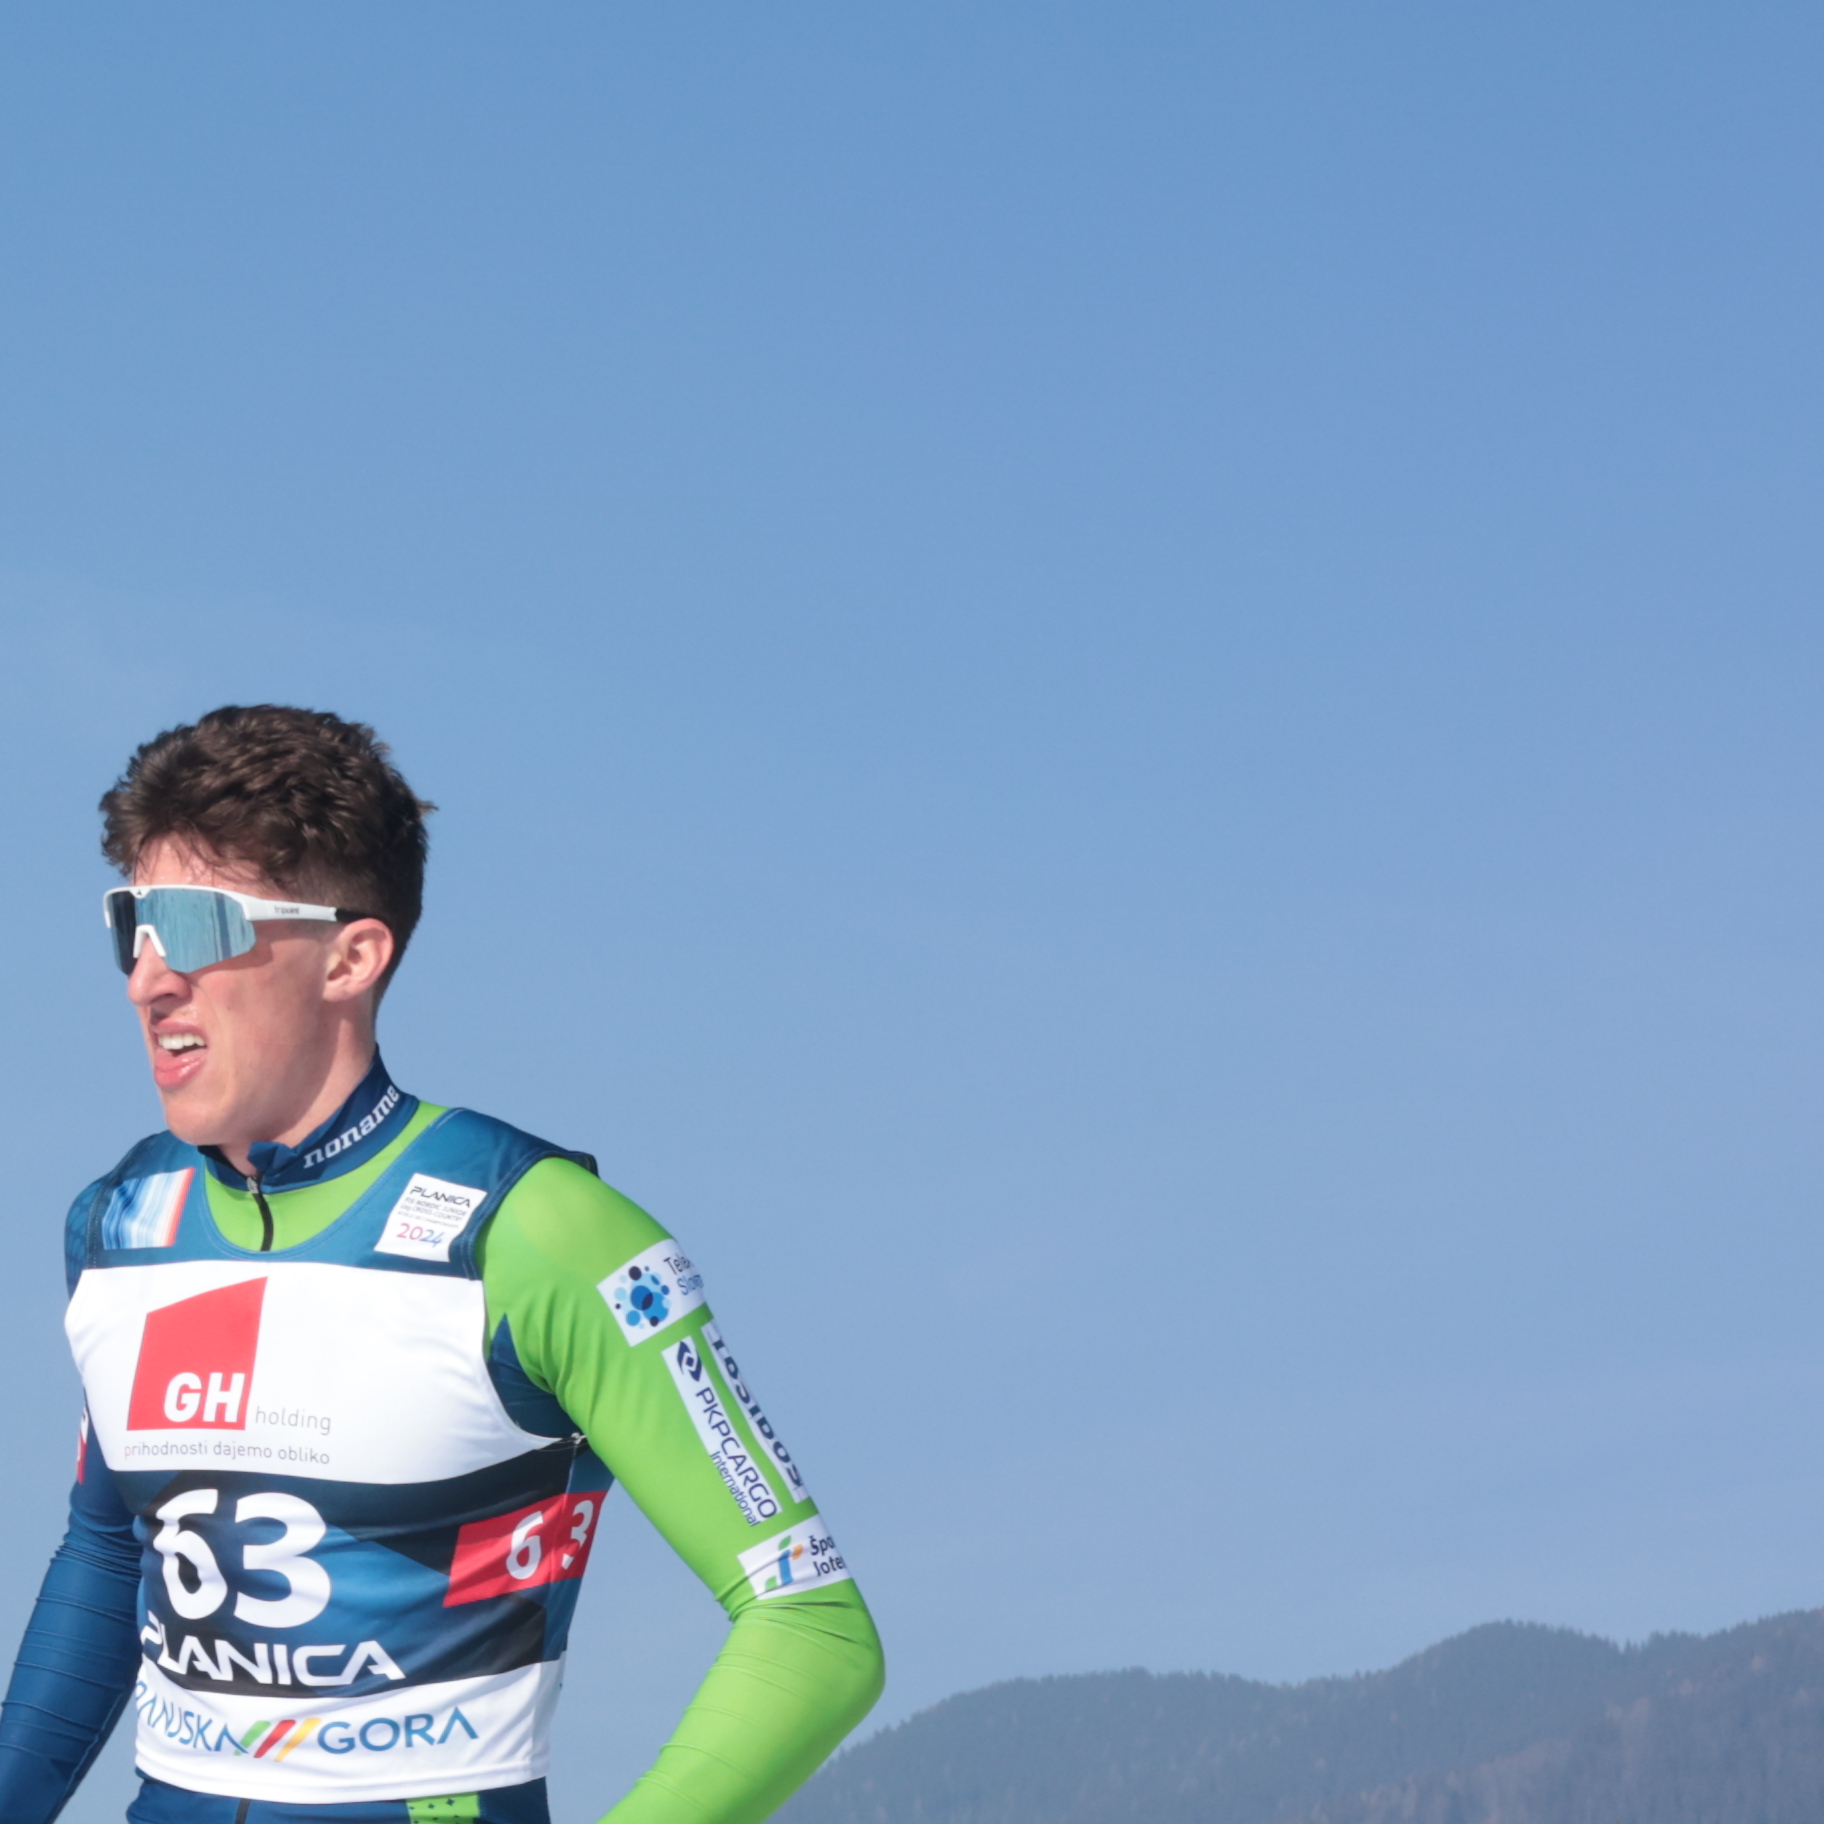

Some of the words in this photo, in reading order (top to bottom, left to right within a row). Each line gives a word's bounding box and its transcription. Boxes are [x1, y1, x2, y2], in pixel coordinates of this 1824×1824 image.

[303, 1085, 400, 1169] noname
[410, 1185, 470, 1208] PLANICA
[396, 1223, 445, 1248] 2024
[163, 1372, 247, 1423] GH
[255, 1406, 331, 1435] holding
[124, 1440, 208, 1460] prihodnosti
[213, 1441, 272, 1459] dajemo
[278, 1446, 330, 1464] obliko
[710, 1451, 760, 1527] International
[152, 1488, 332, 1629] 63
[506, 1500, 594, 1580] 63
[317, 1706, 480, 1755] GORA
